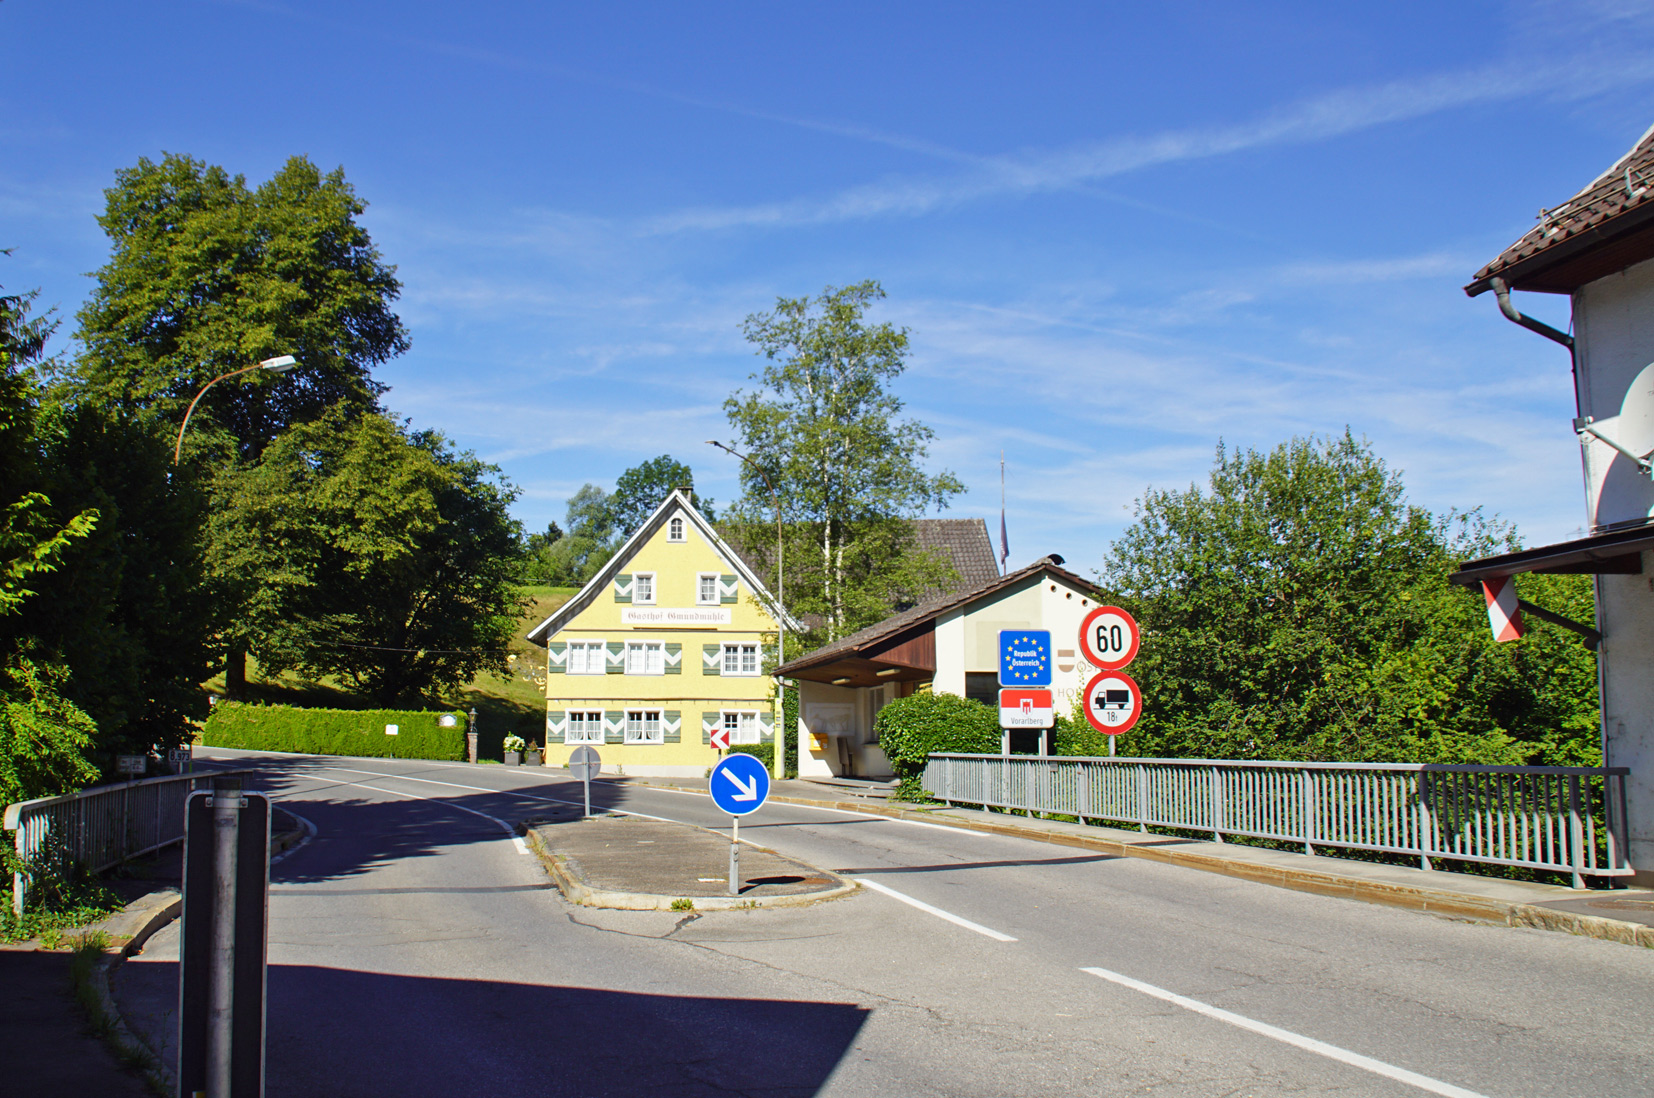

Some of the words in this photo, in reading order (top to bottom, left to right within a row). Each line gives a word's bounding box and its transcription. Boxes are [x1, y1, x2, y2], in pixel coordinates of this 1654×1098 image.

[628, 612, 663, 621] Gasthof
[1096, 625, 1122, 653] 60
[1014, 650, 1037, 658] Republik
[1012, 658, 1040, 666] Österreich
[1010, 717, 1044, 726] Vorarlberg
